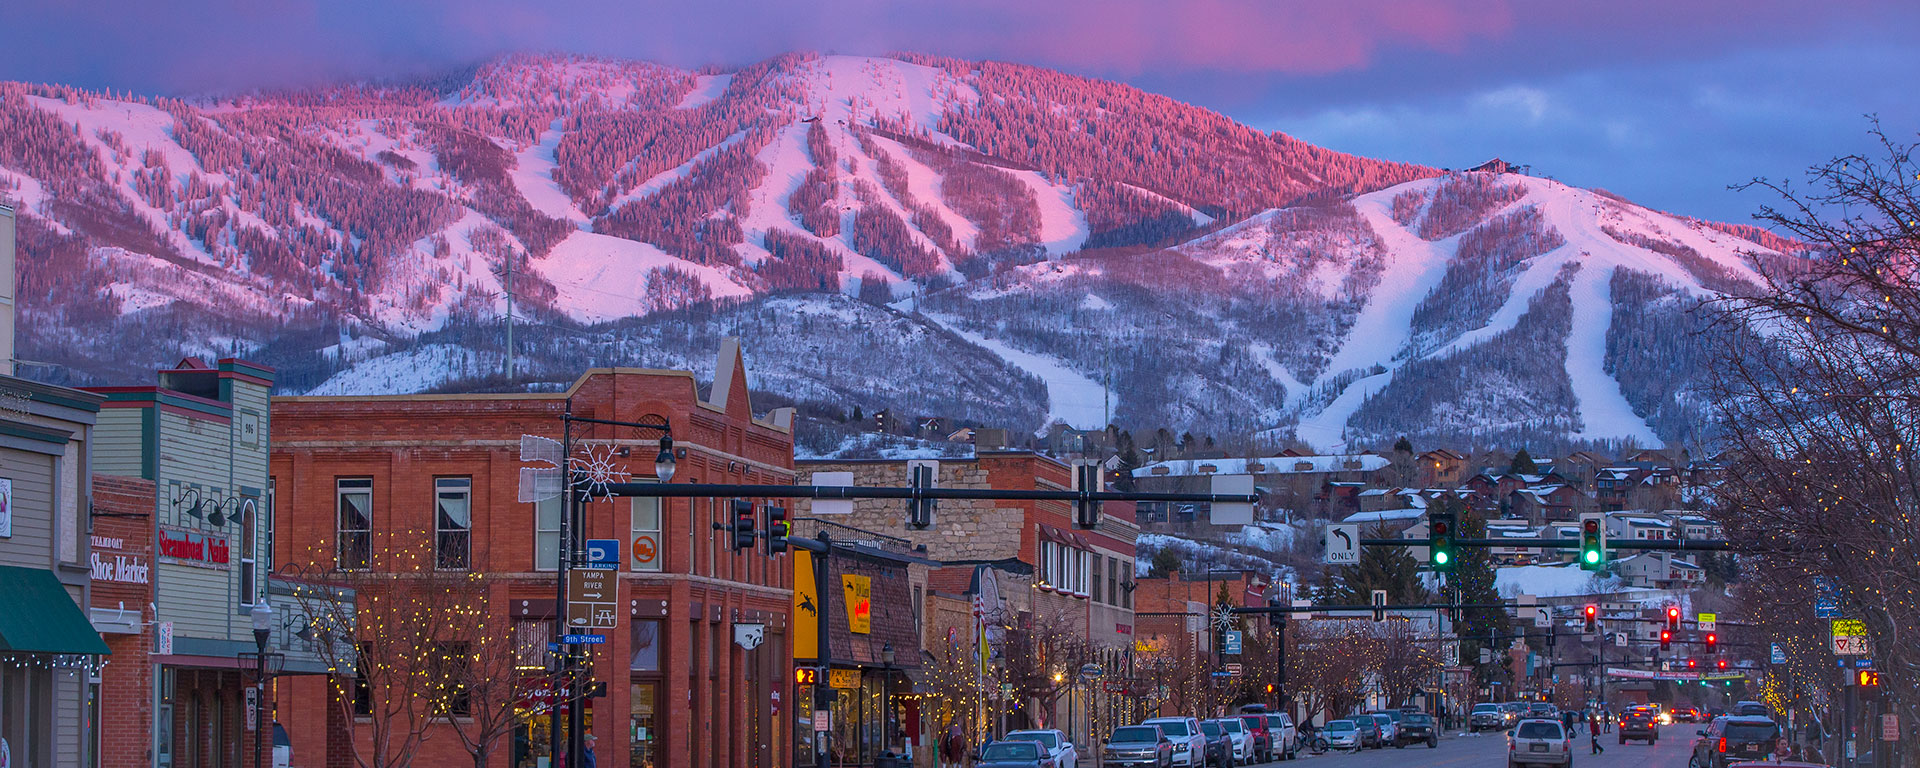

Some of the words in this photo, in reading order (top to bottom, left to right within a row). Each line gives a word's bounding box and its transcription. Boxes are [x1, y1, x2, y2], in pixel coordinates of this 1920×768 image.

[159, 530, 205, 561] Steamboat
[207, 537, 230, 564] Nails
[1331, 552, 1355, 560] ONLY
[90, 551, 114, 581] Shoe
[115, 555, 149, 584] Market
[582, 571, 605, 579] YAMPA
[1227, 634, 1236, 645] P
[807, 670, 814, 683] 2
